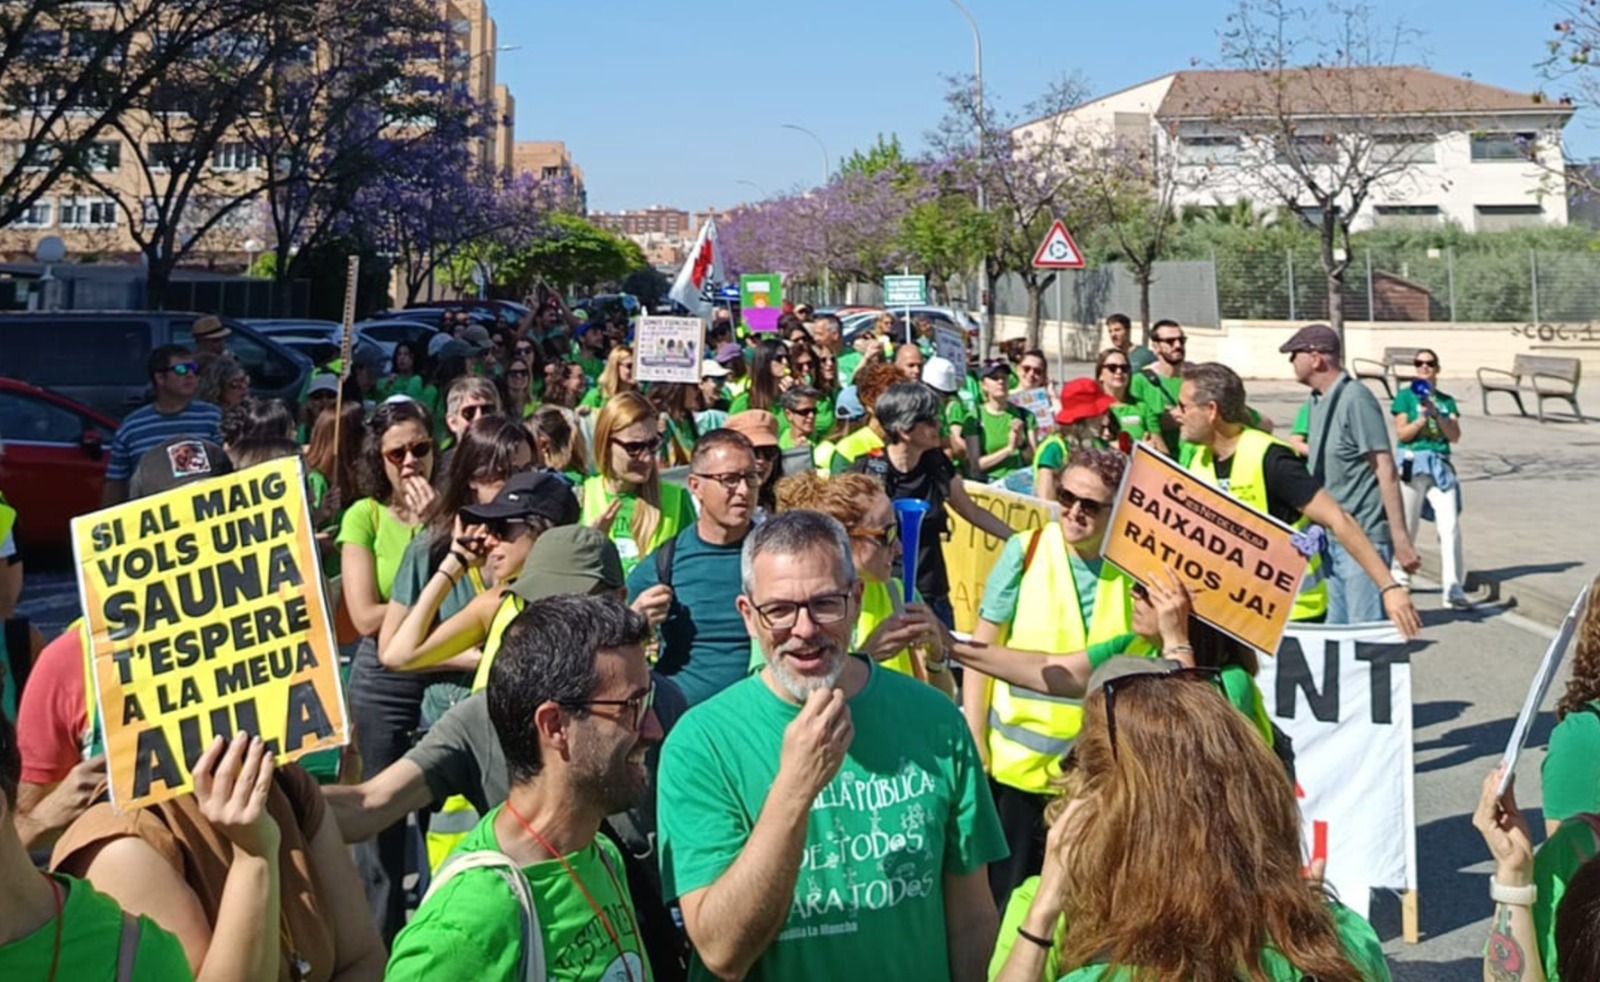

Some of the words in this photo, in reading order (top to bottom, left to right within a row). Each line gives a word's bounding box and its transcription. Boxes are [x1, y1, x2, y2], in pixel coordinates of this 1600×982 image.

[91, 516, 125, 553] SI
[139, 502, 180, 540] AL
[192, 471, 287, 521] MAIG
[98, 536, 199, 588] VOLS
[213, 506, 295, 553] UNA
[1128, 486, 1244, 568] BAIXADA
[1254, 560, 1295, 593] DE
[103, 543, 303, 641] SAUNA
[1124, 520, 1221, 591] RÀTIOS
[1229, 587, 1276, 620] JA!
[112, 595, 312, 685] T'ESPERE
[122, 692, 145, 726] A
[158, 676, 203, 715] LA
[215, 642, 319, 697] MEUA
[1275, 636, 1410, 725] NT
[133, 680, 335, 799] AULA
[789, 886, 844, 919] ARA
